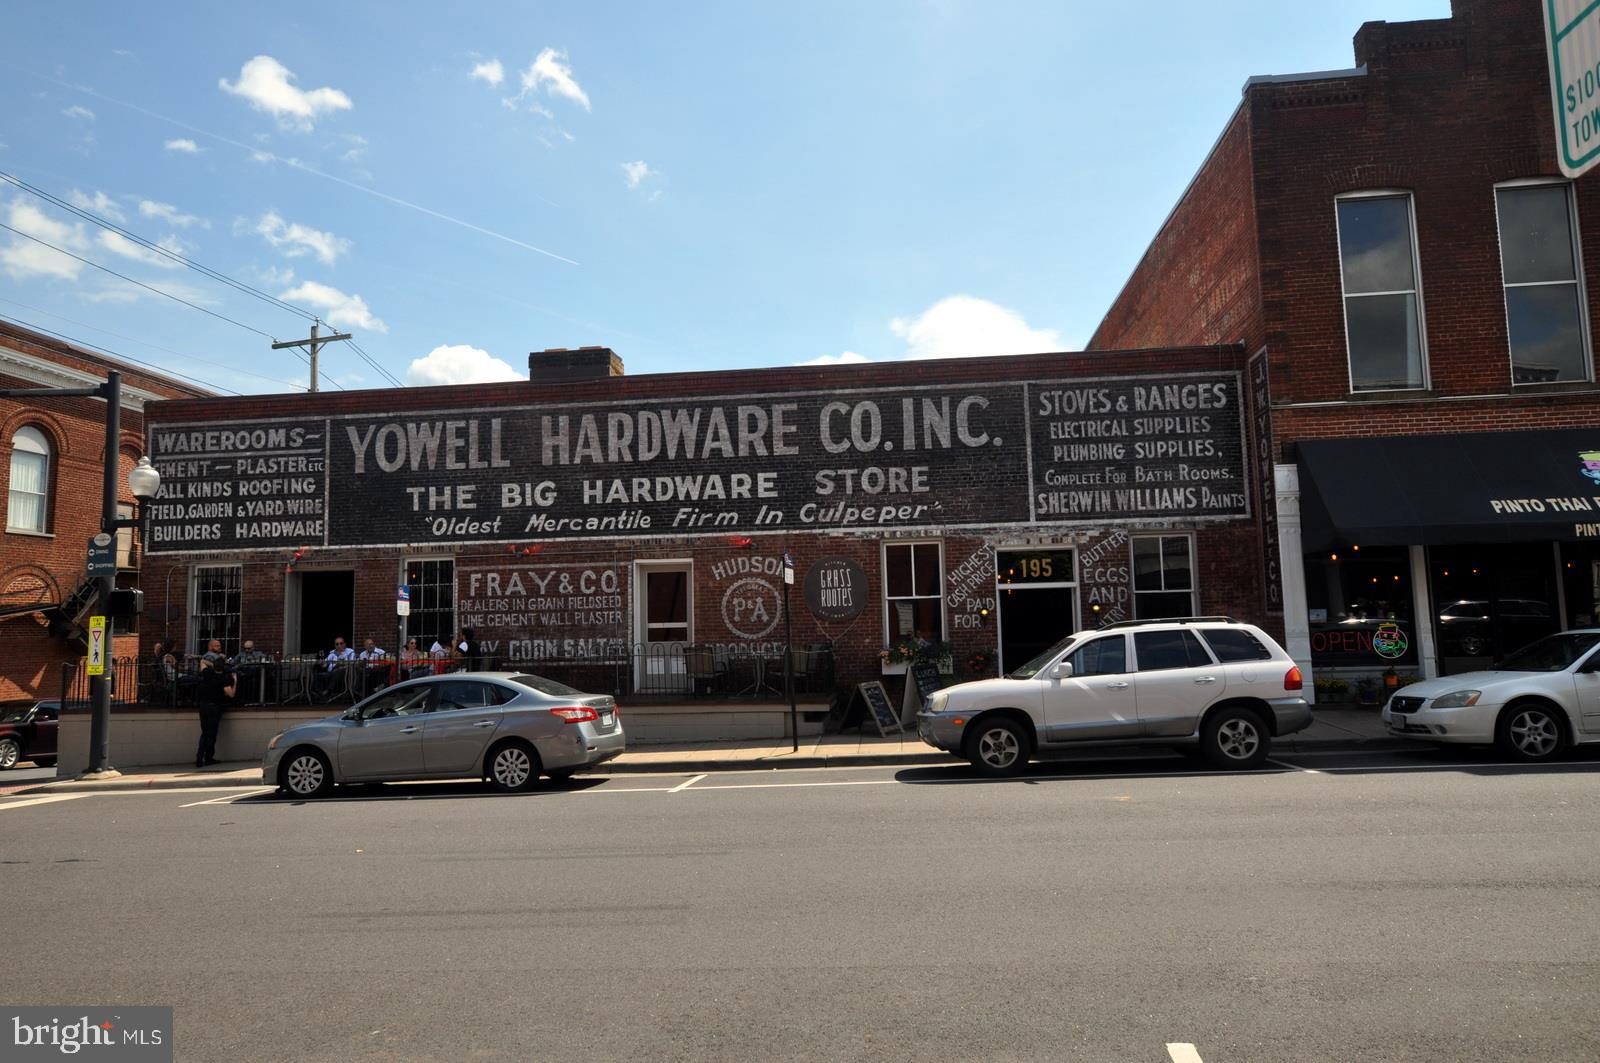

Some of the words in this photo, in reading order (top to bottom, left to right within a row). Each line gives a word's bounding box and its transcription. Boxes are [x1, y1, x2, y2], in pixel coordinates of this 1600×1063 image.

[1039, 388, 1111, 416] STOVES
[1116, 395, 1128, 412] &
[1134, 383, 1227, 411] RANGES
[1050, 419, 1129, 439] ELECTRICAL
[1134, 416, 1211, 436] SUPPLIES
[346, 418, 511, 474] YOWELL
[541, 403, 799, 466] HARDWARE
[1054, 443, 1126, 462] PLUMBING
[237, 457, 308, 474] PLASTER
[309, 462, 325, 472] ETC
[1045, 469, 1101, 485] COMPLETE
[1105, 467, 1127, 483] FOR
[1135, 466, 1172, 482] BATH
[1178, 464, 1234, 480] ROOMS.
[156, 483, 184, 499] ALL
[188, 482, 232, 498] KINDS
[239, 478, 316, 496] ROOFING
[406, 485, 477, 511] THE
[501, 481, 557, 508] BIG
[583, 472, 778, 504] HARDWARE
[815, 466, 929, 495] STORE
[287, 499, 323, 515] WIRE
[1038, 490, 1112, 514] SHERWIN
[1115, 488, 1197, 511] WILLIAMS
[1202, 486, 1245, 508] PAINTS
[1490, 500, 1546, 513] PINTO
[1546, 497, 1592, 512] THAI
[425, 516, 501, 535] "Oldest
[525, 510, 651, 533] Mercantile
[672, 508, 738, 527] Firm
[755, 505, 783, 524] In
[154, 524, 221, 541] BUILDERS
[235, 520, 323, 538] HARDWARE
[1080, 531, 1128, 568] BUTTER
[947, 543, 996, 586] HIGHEST
[1020, 558, 1052, 578] 195
[820, 569, 852, 588] GRASS
[946, 583, 973, 608] CASH
[969, 560, 996, 590] PRICE
[1083, 567, 1129, 583] EGGS
[460, 600, 509, 612] DEALERS
[513, 599, 524, 610] IN
[528, 597, 565, 609] GRAIN
[821, 588, 853, 607] ROOTES
[1088, 586, 1128, 603] AND
[461, 615, 485, 627] LIME
[487, 612, 537, 626] CEMENT
[540, 613, 572, 625] WALL
[575, 611, 623, 624] PLASTER
[954, 614, 982, 628] FOR
[508, 640, 557, 660] CORN
[563, 638, 606, 657] SALT
[1312, 632, 1373, 652] OPEN
